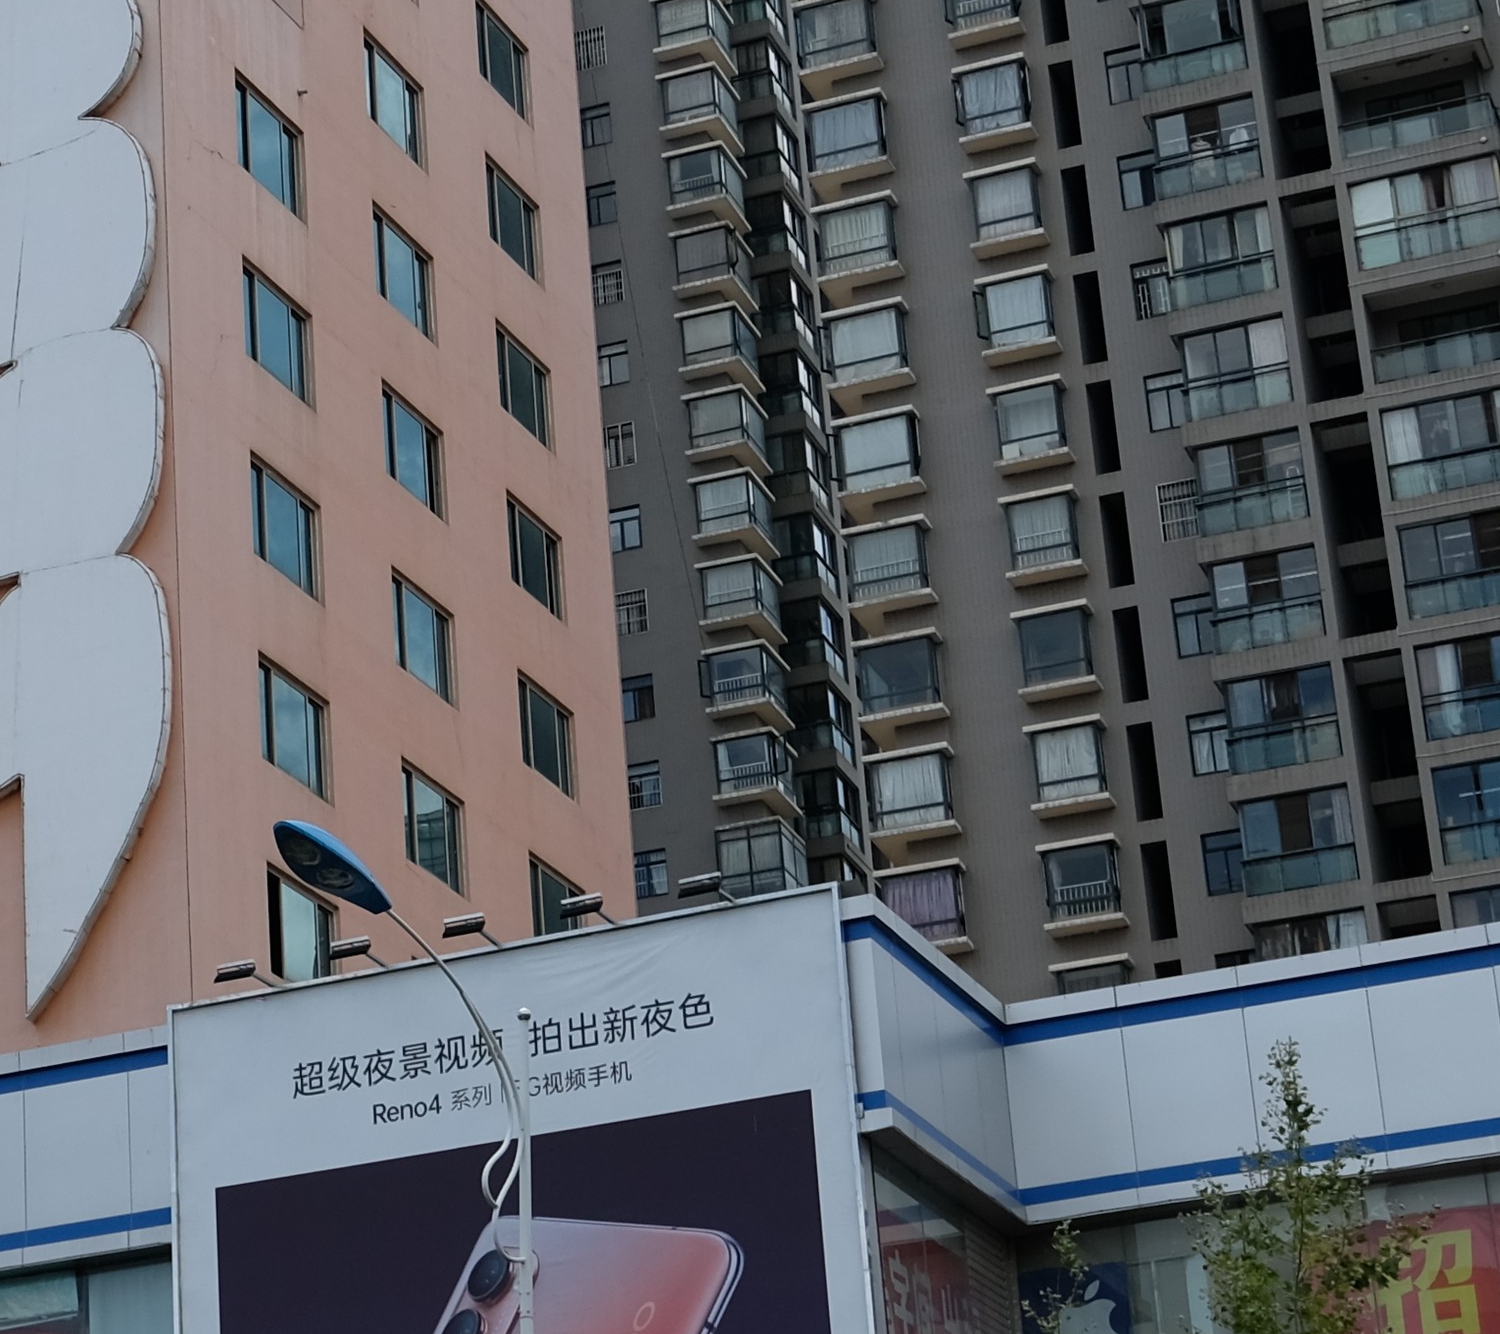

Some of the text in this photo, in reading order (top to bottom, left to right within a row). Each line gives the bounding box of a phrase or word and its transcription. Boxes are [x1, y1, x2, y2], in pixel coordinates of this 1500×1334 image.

[292, 991, 716, 1100] 超级夜景视频 拍出新夜色
[372, 1061, 633, 1125] Reno4 系列 G视频手机
